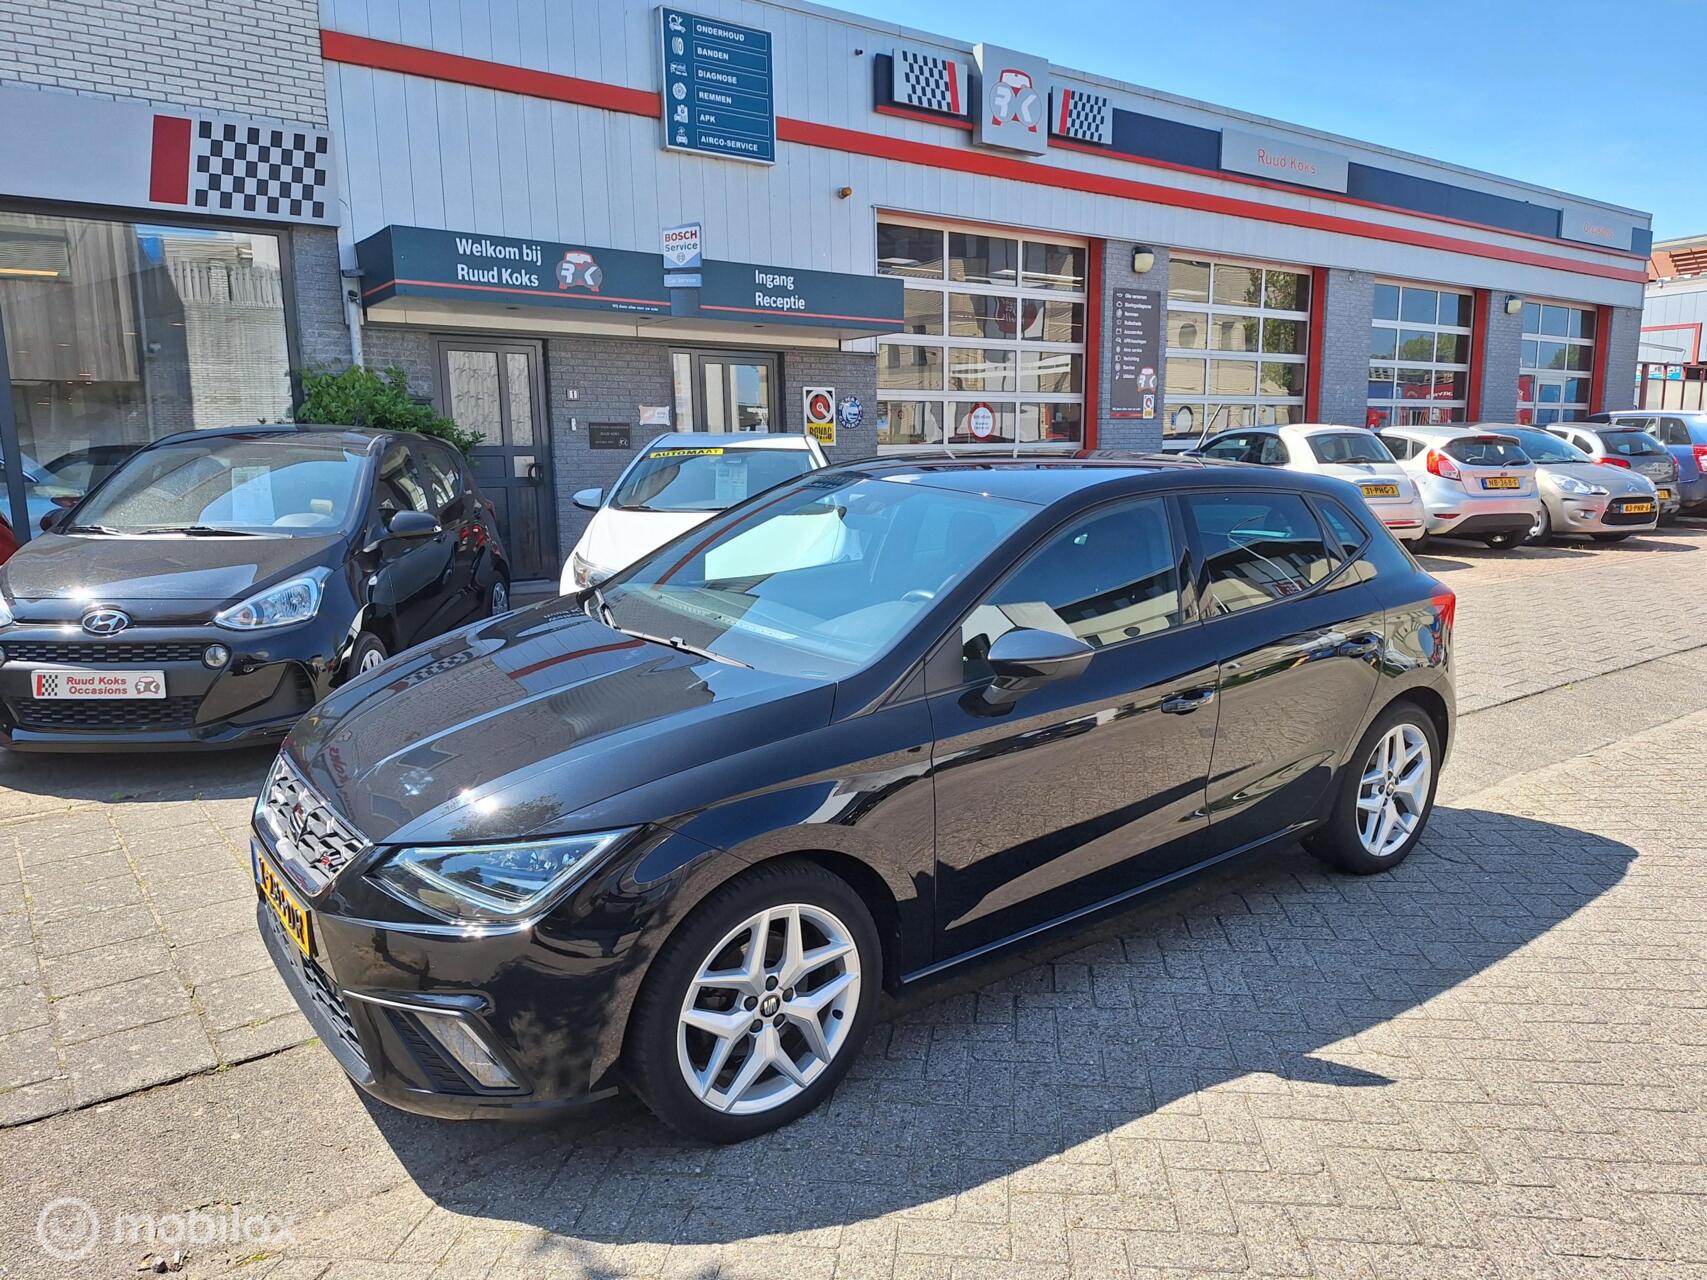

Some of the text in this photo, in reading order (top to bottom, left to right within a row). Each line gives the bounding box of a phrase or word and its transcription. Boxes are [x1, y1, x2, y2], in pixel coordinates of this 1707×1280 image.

[696, 24, 745, 42] ONDERHOUD
[697, 47, 729, 60] BANDEN
[698, 70, 737, 84] DIAGNOSE
[699, 91, 732, 105] REMMEN
[700, 114, 716, 123] APK
[701, 136, 758, 152] AIRCO-SERVICE
[1257, 148, 1317, 175] Ruud Koks
[664, 230, 697, 242] BOSCH
[456, 238, 542, 266] Welkom bij
[665, 242, 698, 252] Service
[456, 263, 539, 287] Ruud Koks
[755, 269, 795, 290] Ingang
[755, 292, 806, 312] Receptie
[654, 449, 718, 458] AUTOMAAT
[66, 676, 127, 685] Ruud Koks
[68, 686, 128, 695] Occasions
